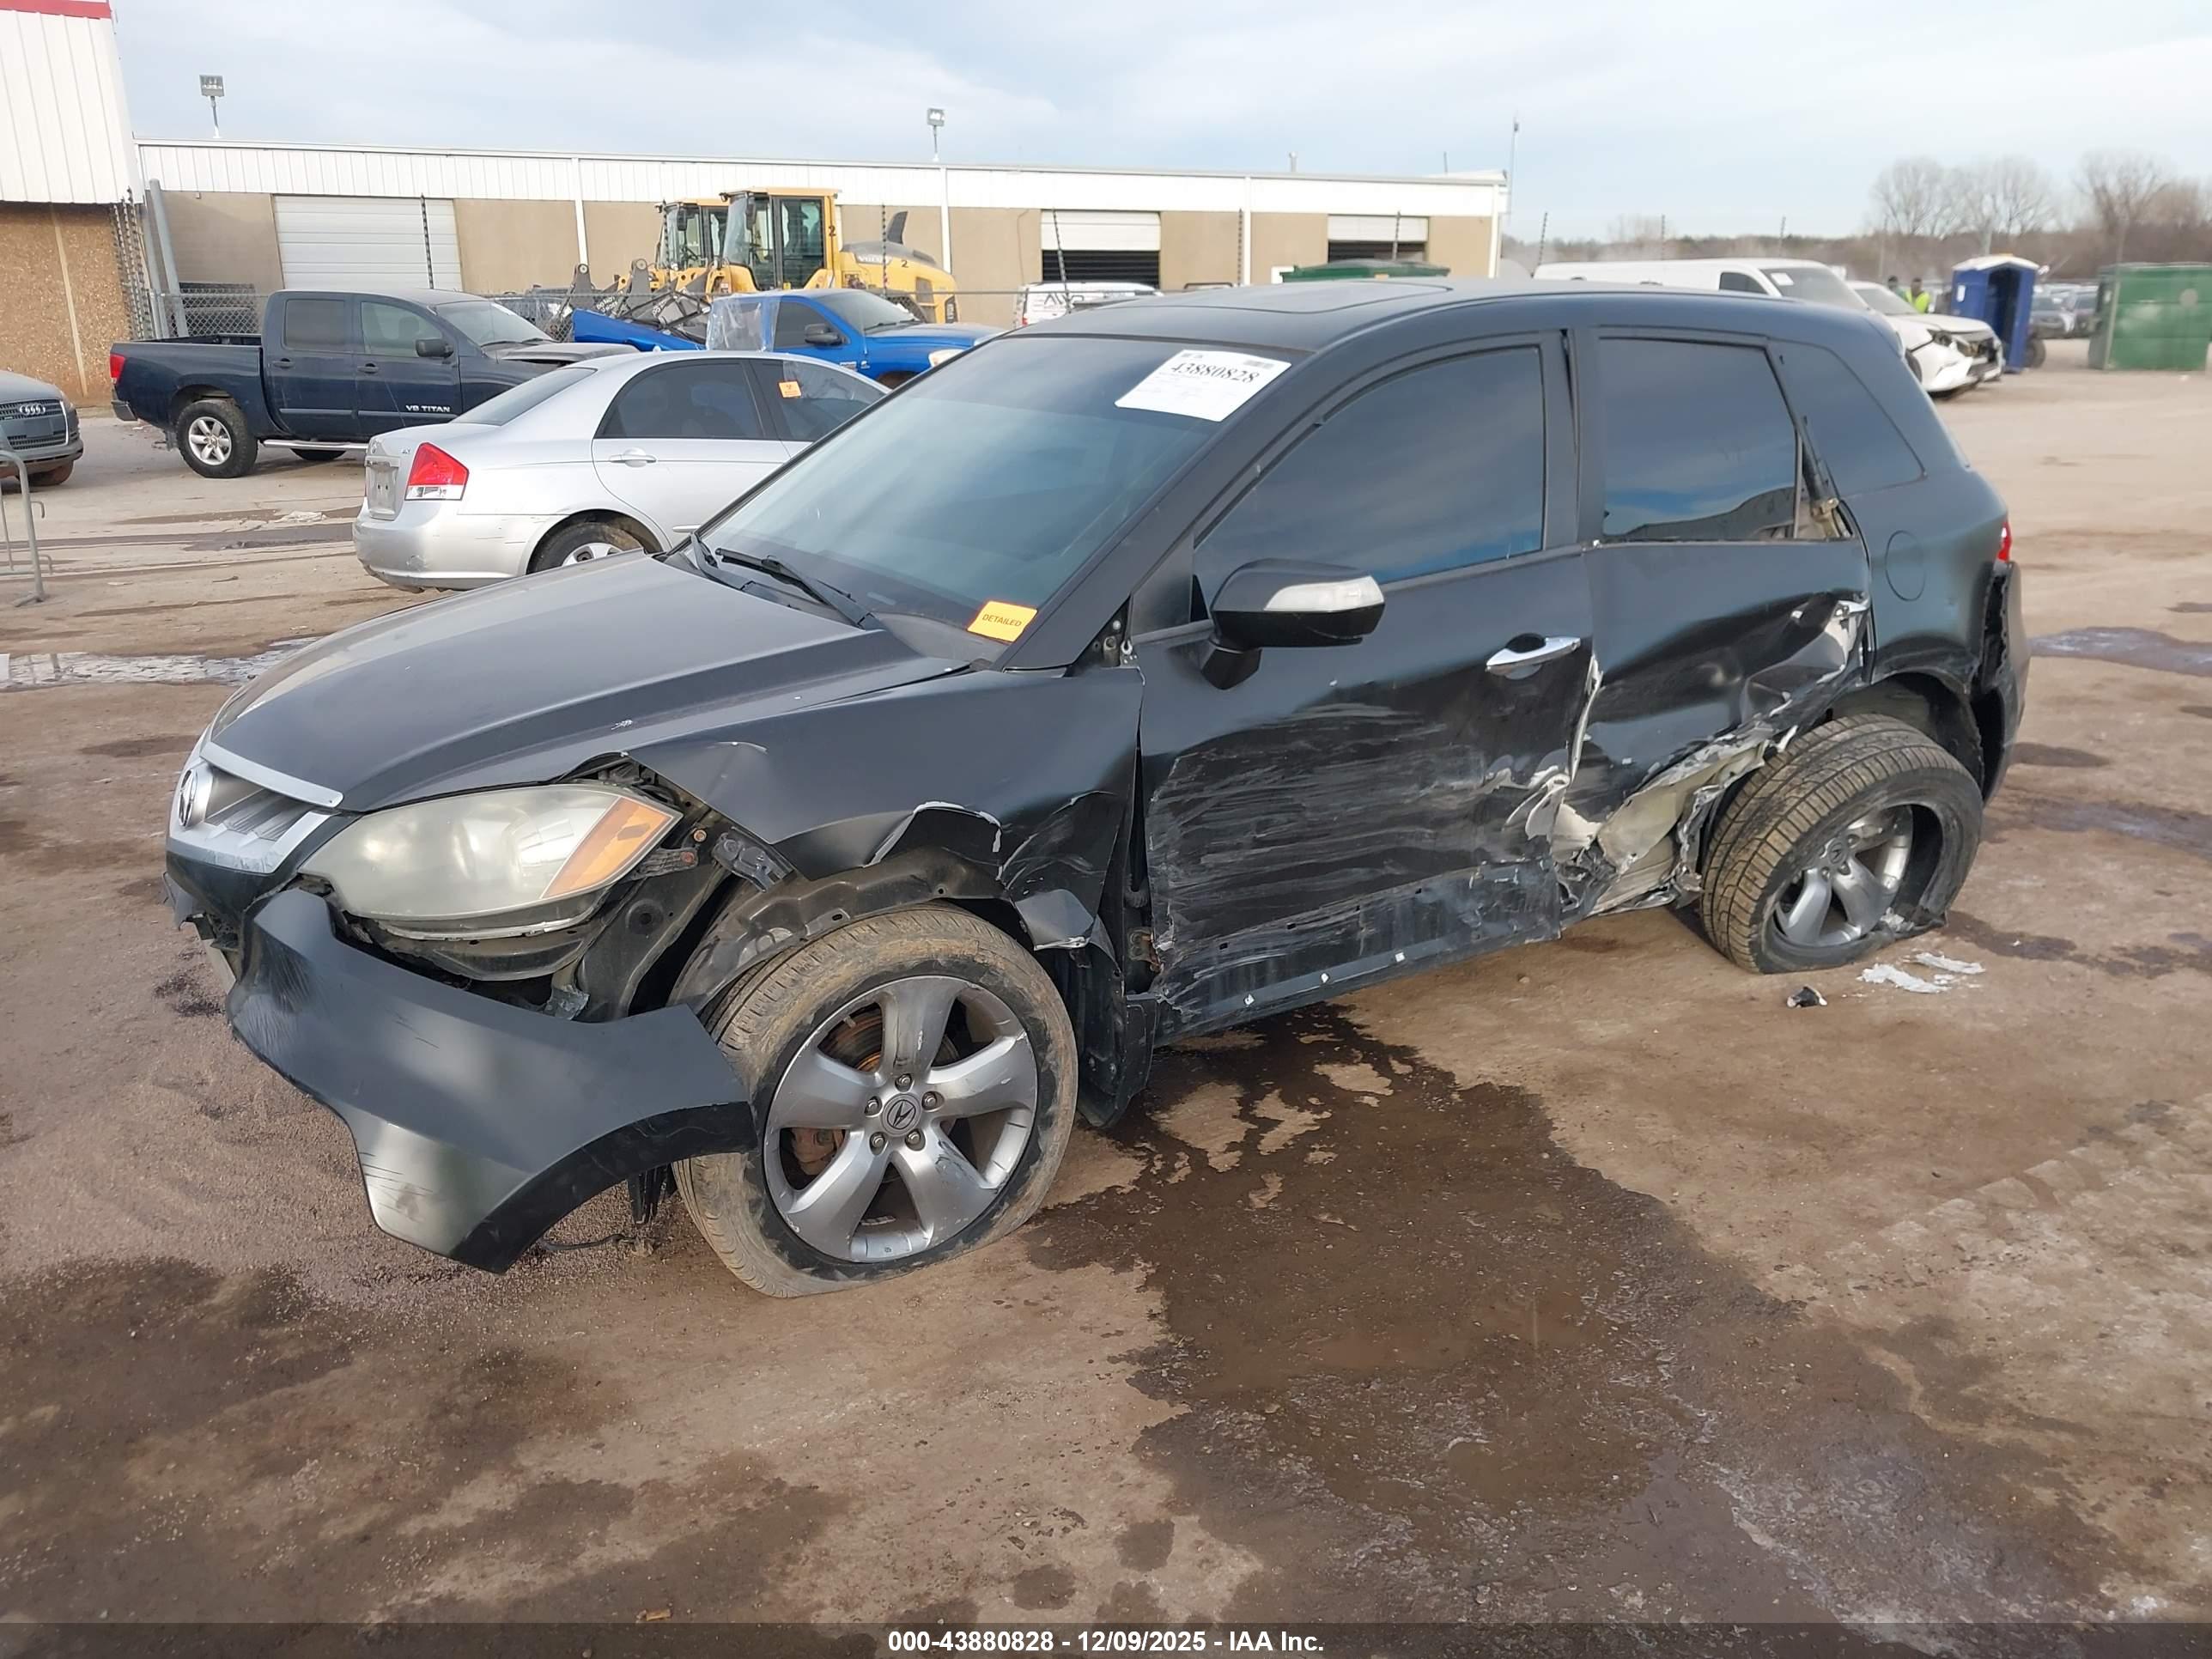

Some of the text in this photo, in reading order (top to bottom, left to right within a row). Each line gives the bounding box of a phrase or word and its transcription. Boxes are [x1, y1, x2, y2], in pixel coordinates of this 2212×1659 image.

[829, 225, 836, 237] 2
[901, 259, 908, 268] 2
[1170, 362, 1260, 383] 43880828
[982, 614, 1022, 627] DETAILED
